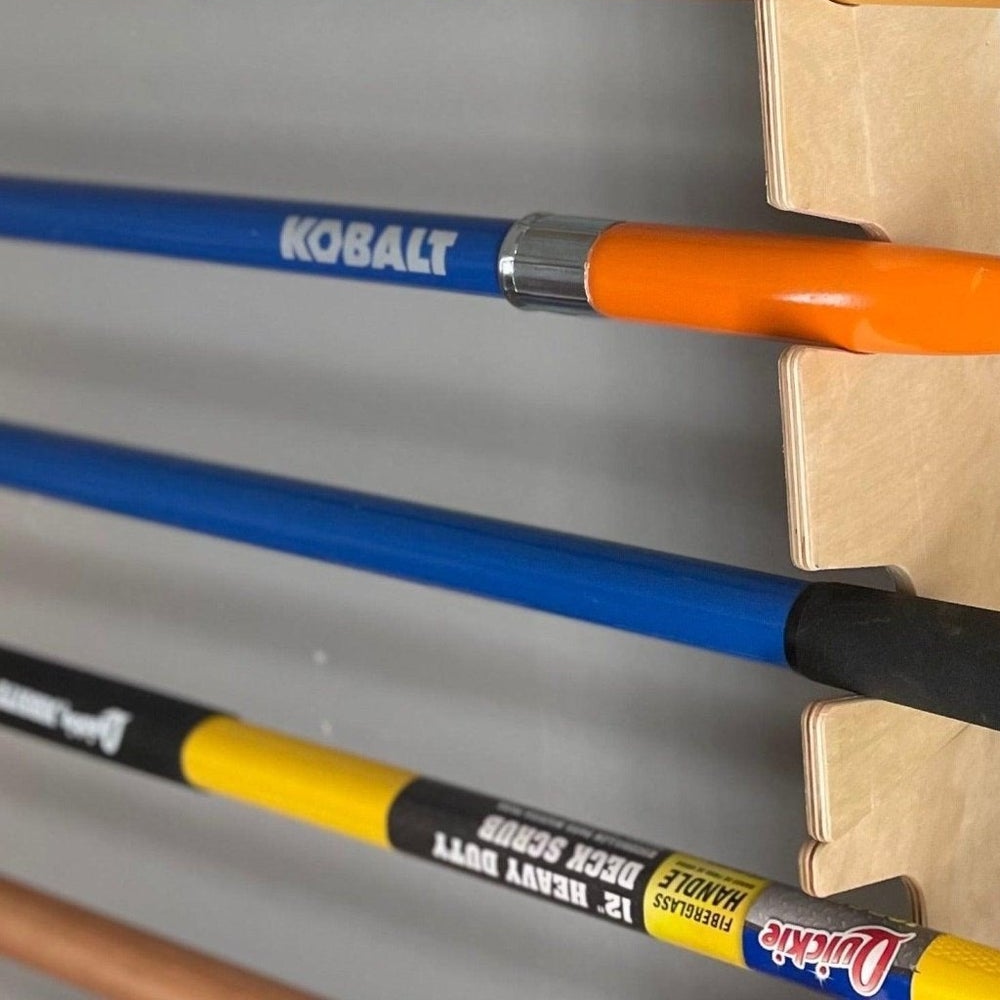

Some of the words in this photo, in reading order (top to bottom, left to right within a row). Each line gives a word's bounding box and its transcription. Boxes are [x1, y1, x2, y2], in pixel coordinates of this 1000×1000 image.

[280, 215, 458, 276] KOBALT
[432, 831, 499, 877] DUTY
[476, 813, 569, 864] SCRUB
[505, 857, 589, 908] HEAVY
[565, 842, 646, 891] DECK
[658, 868, 748, 912] HANDLE
[597, 891, 633, 924] 12"
[653, 892, 733, 933] FIBERGLASS
[759, 920, 916, 996] Quickie
